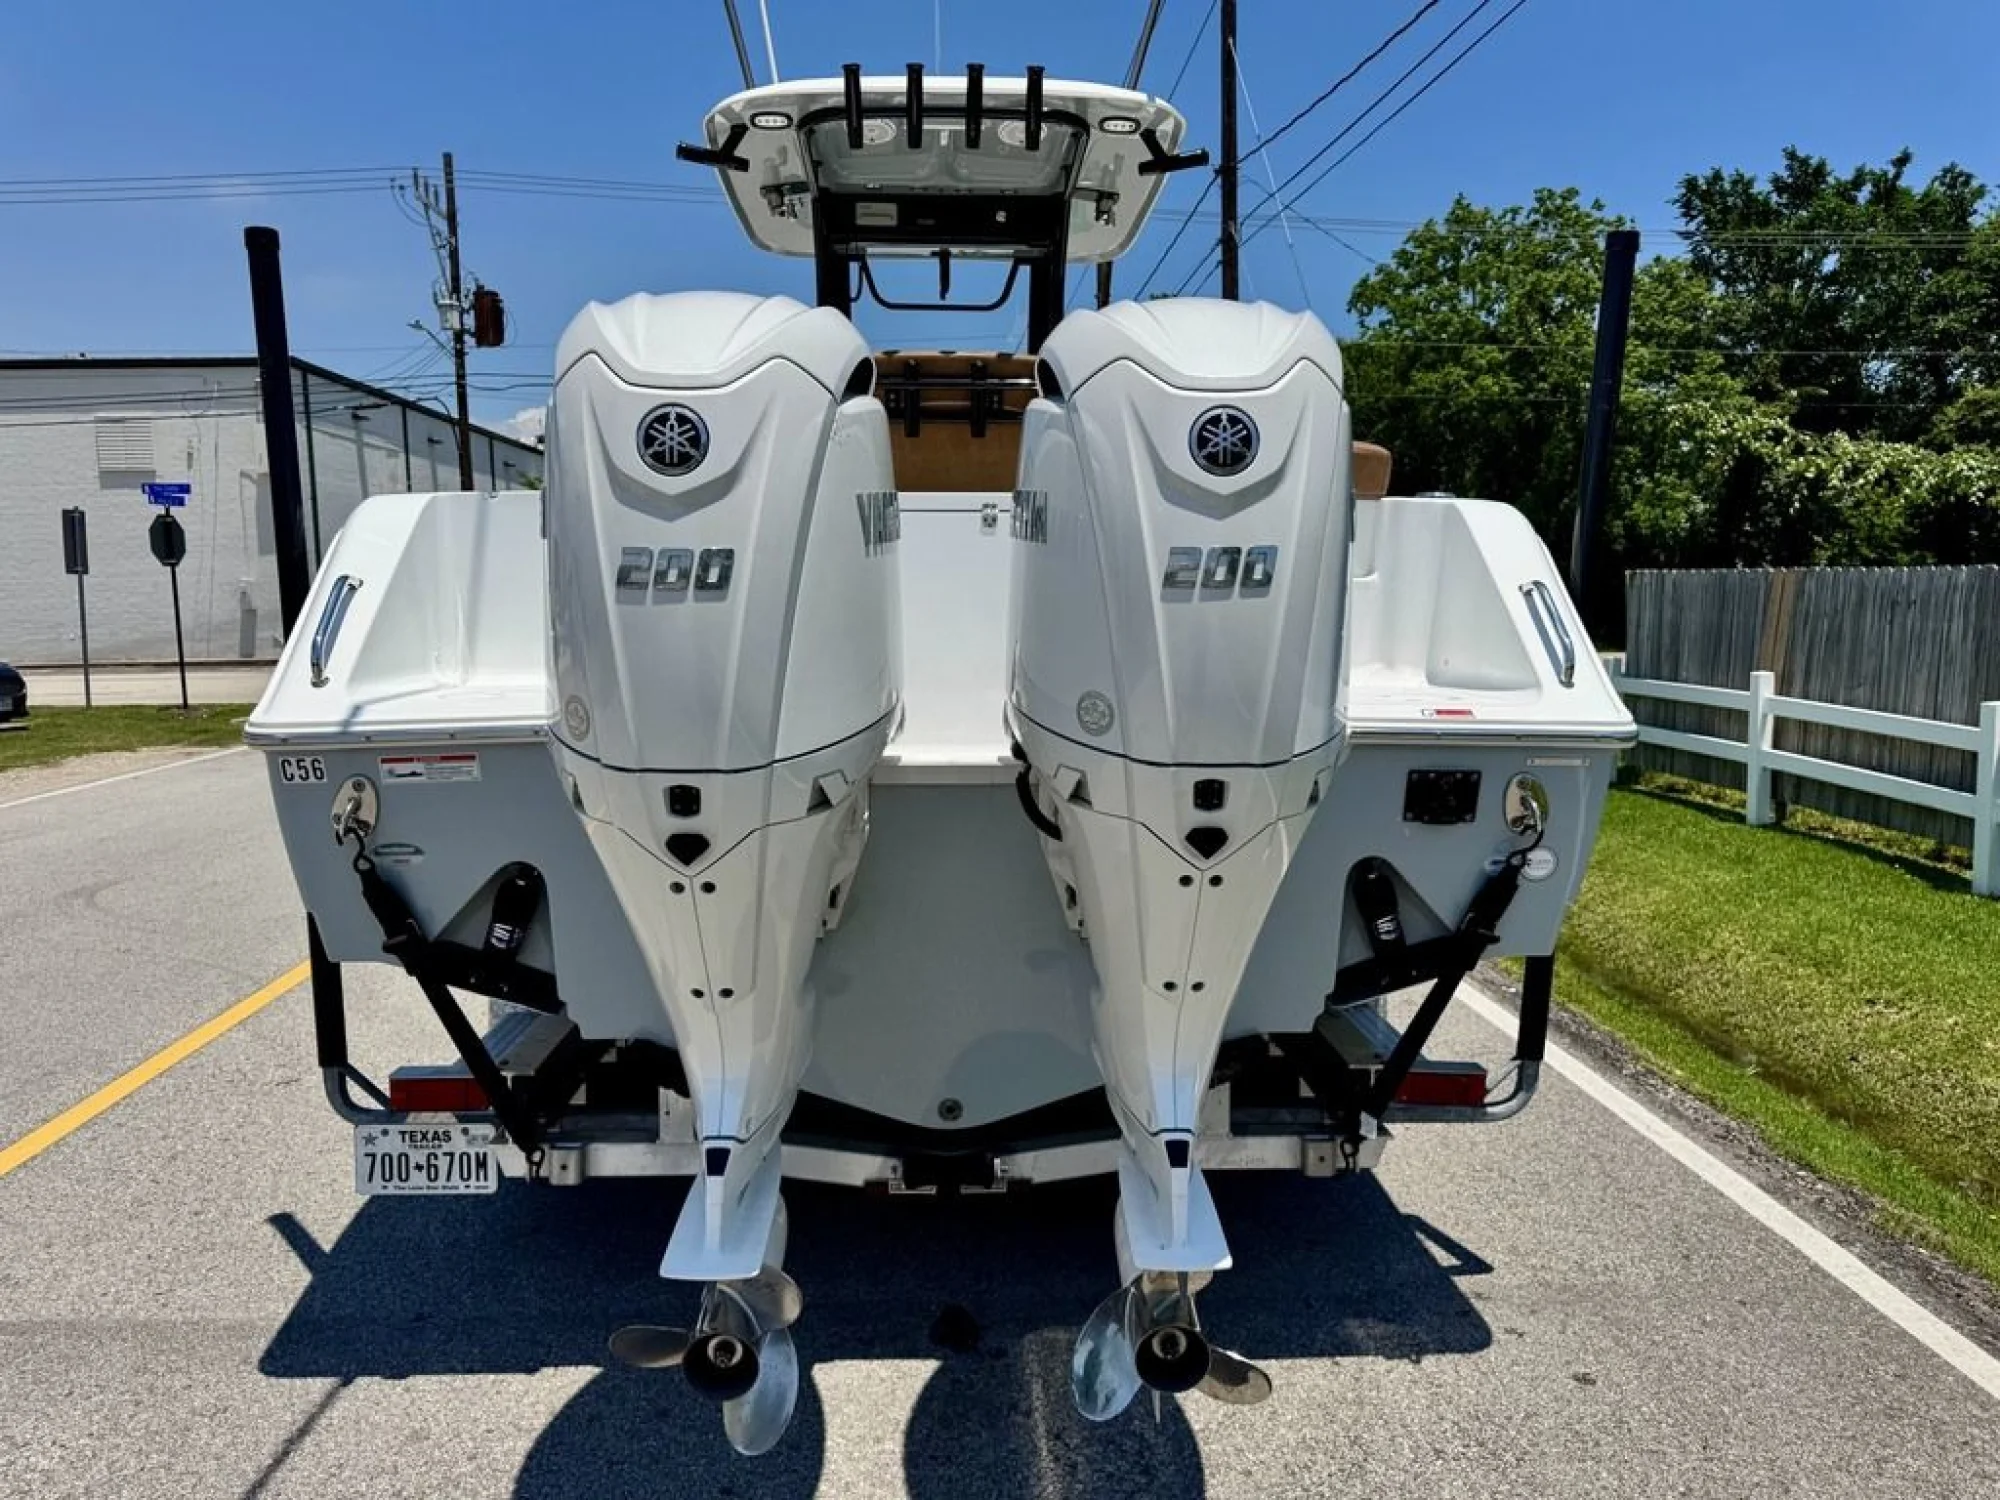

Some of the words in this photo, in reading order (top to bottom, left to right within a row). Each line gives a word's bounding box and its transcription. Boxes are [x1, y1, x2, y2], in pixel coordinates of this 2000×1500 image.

[616, 546, 735, 599] 200
[1161, 545, 1279, 597] 200
[280, 759, 325, 782] C56
[398, 1130, 452, 1143] TEXAS
